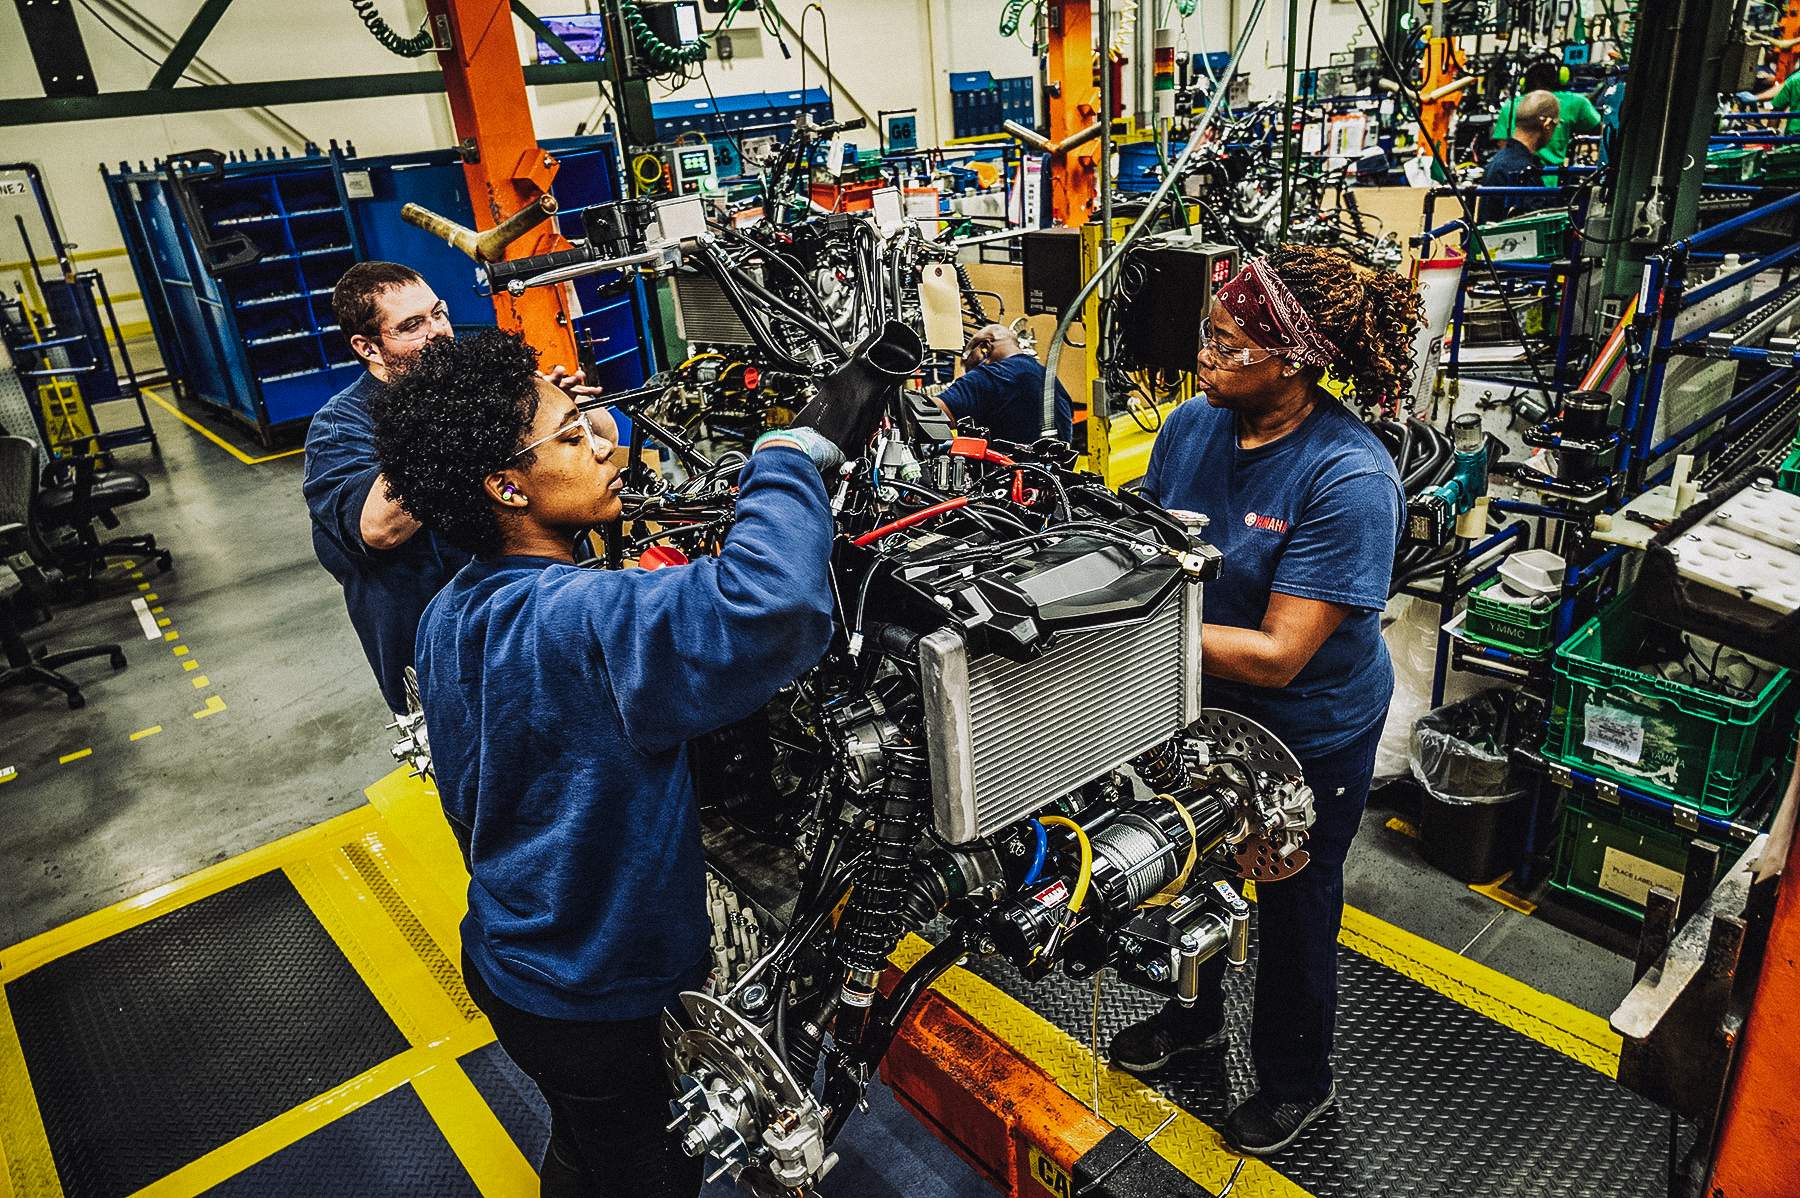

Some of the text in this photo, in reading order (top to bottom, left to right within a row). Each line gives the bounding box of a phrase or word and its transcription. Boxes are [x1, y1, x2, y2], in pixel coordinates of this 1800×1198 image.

[892, 123, 912, 139] G6
[17, 182, 25, 193] 2
[1489, 621, 1526, 640] YMMC
[1612, 866, 1633, 879] PLACE
[1634, 874, 1652, 886] LABEL
